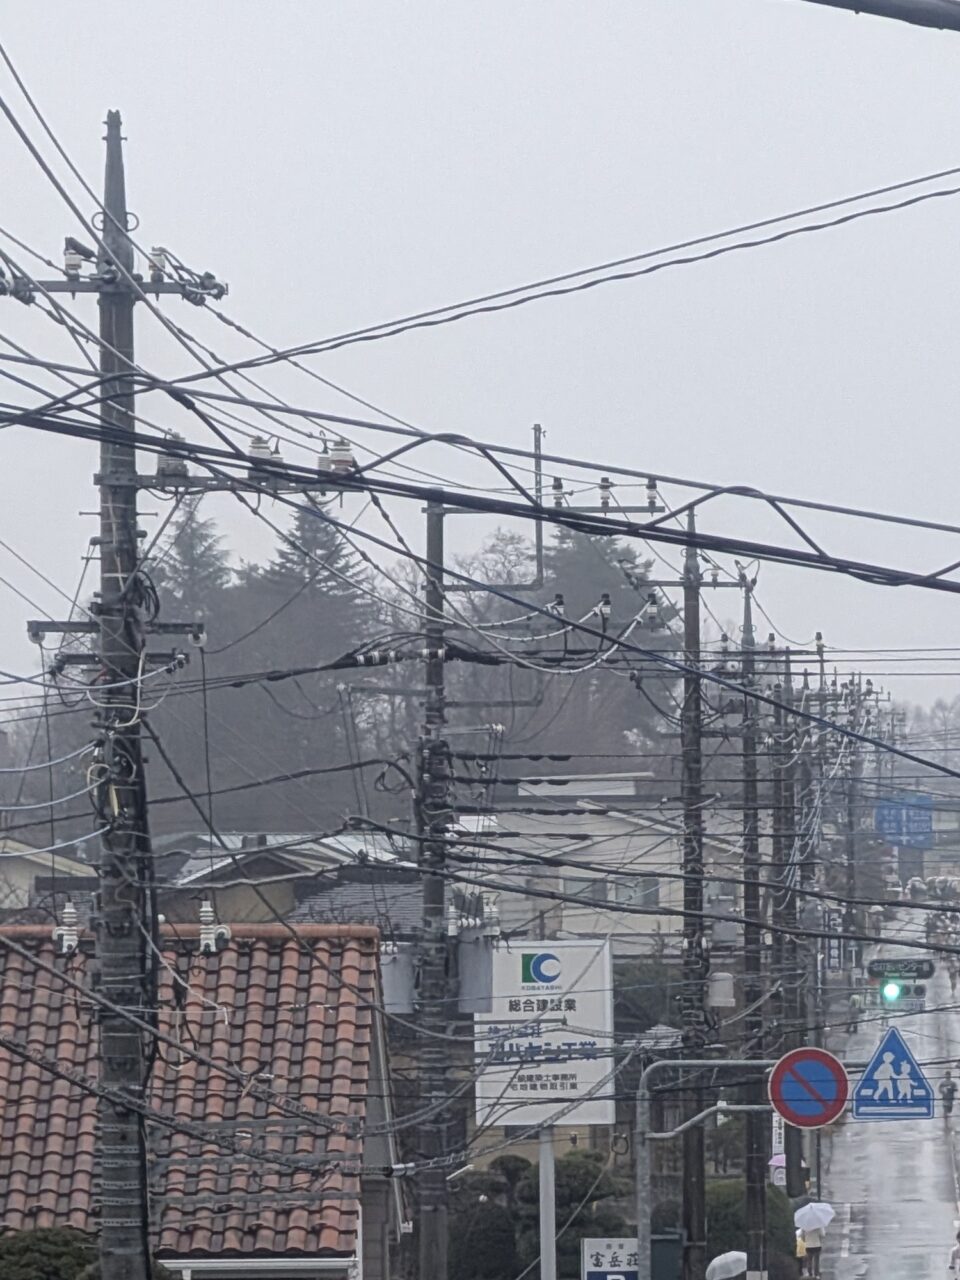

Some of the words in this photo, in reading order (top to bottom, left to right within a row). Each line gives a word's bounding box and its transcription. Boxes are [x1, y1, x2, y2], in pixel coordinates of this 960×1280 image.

[508, 999, 577, 1012] 総合建設業
